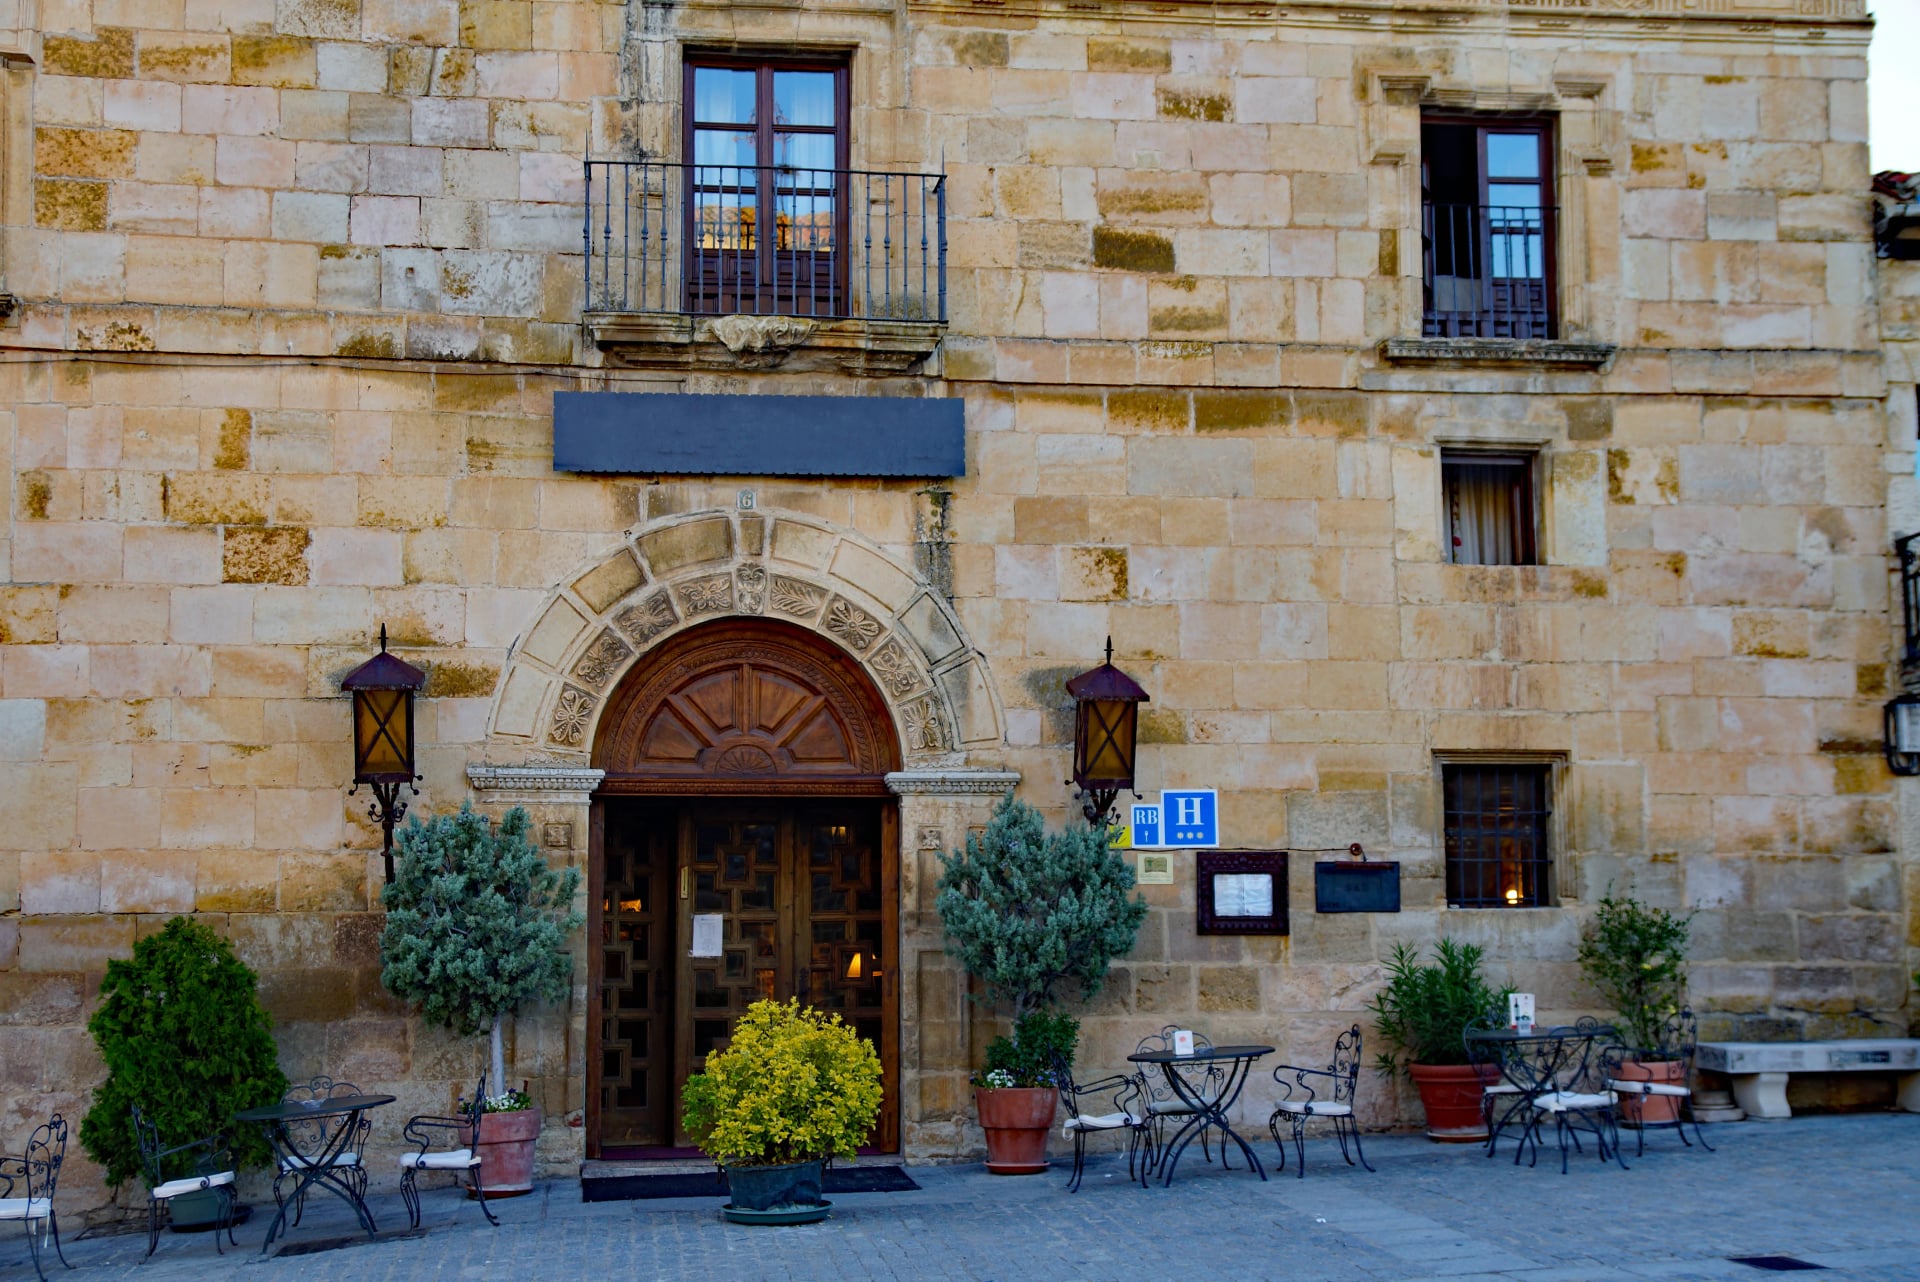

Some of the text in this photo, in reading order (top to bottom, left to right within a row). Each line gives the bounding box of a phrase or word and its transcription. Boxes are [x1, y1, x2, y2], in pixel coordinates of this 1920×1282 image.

[742, 495, 752, 507] 6
[1135, 809, 1158, 825] RB
[1175, 797, 1205, 826] H
